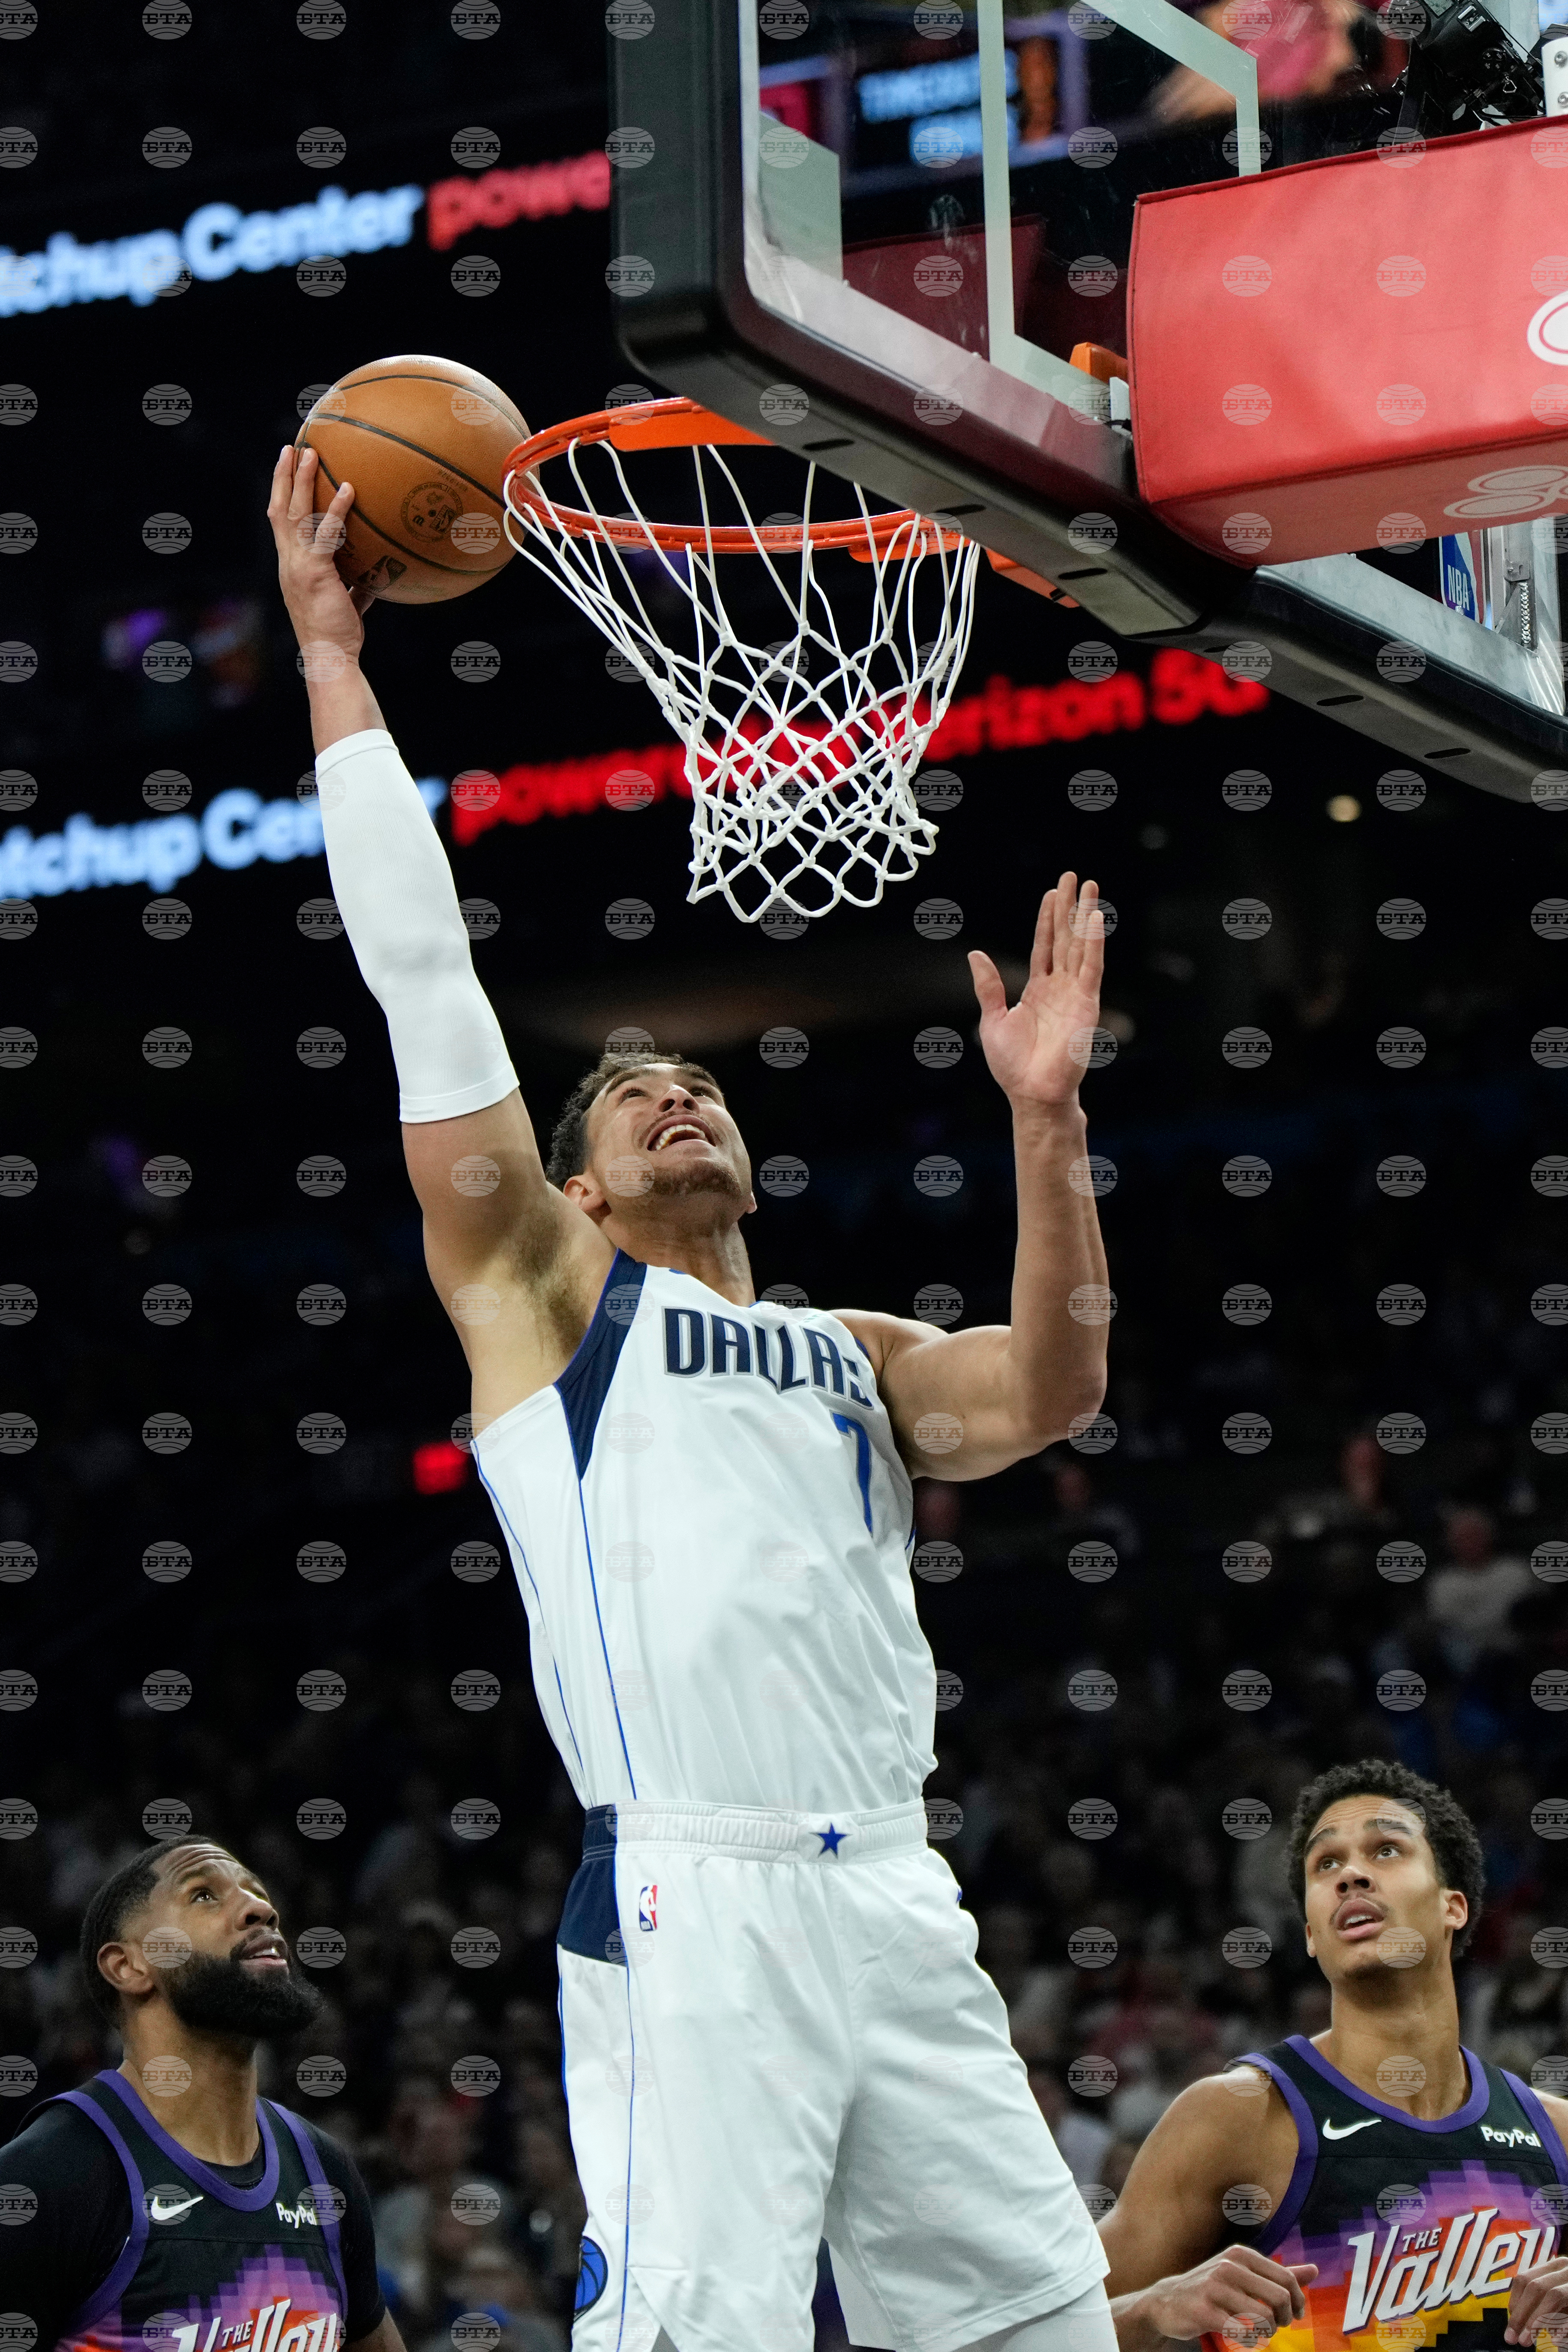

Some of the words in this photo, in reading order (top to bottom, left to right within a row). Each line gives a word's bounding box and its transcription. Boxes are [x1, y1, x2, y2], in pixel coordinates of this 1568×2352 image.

[181, 184, 424, 281] Center
[1447, 564, 1470, 612] NBA
[829, 1409, 873, 1538] 7
[1480, 2126, 1541, 2148] PayPal
[276, 2202, 317, 2229] PayPal
[1403, 2228, 1442, 2253] THE
[1342, 2208, 1556, 2332] Valley
[222, 2321, 254, 2347] THE
